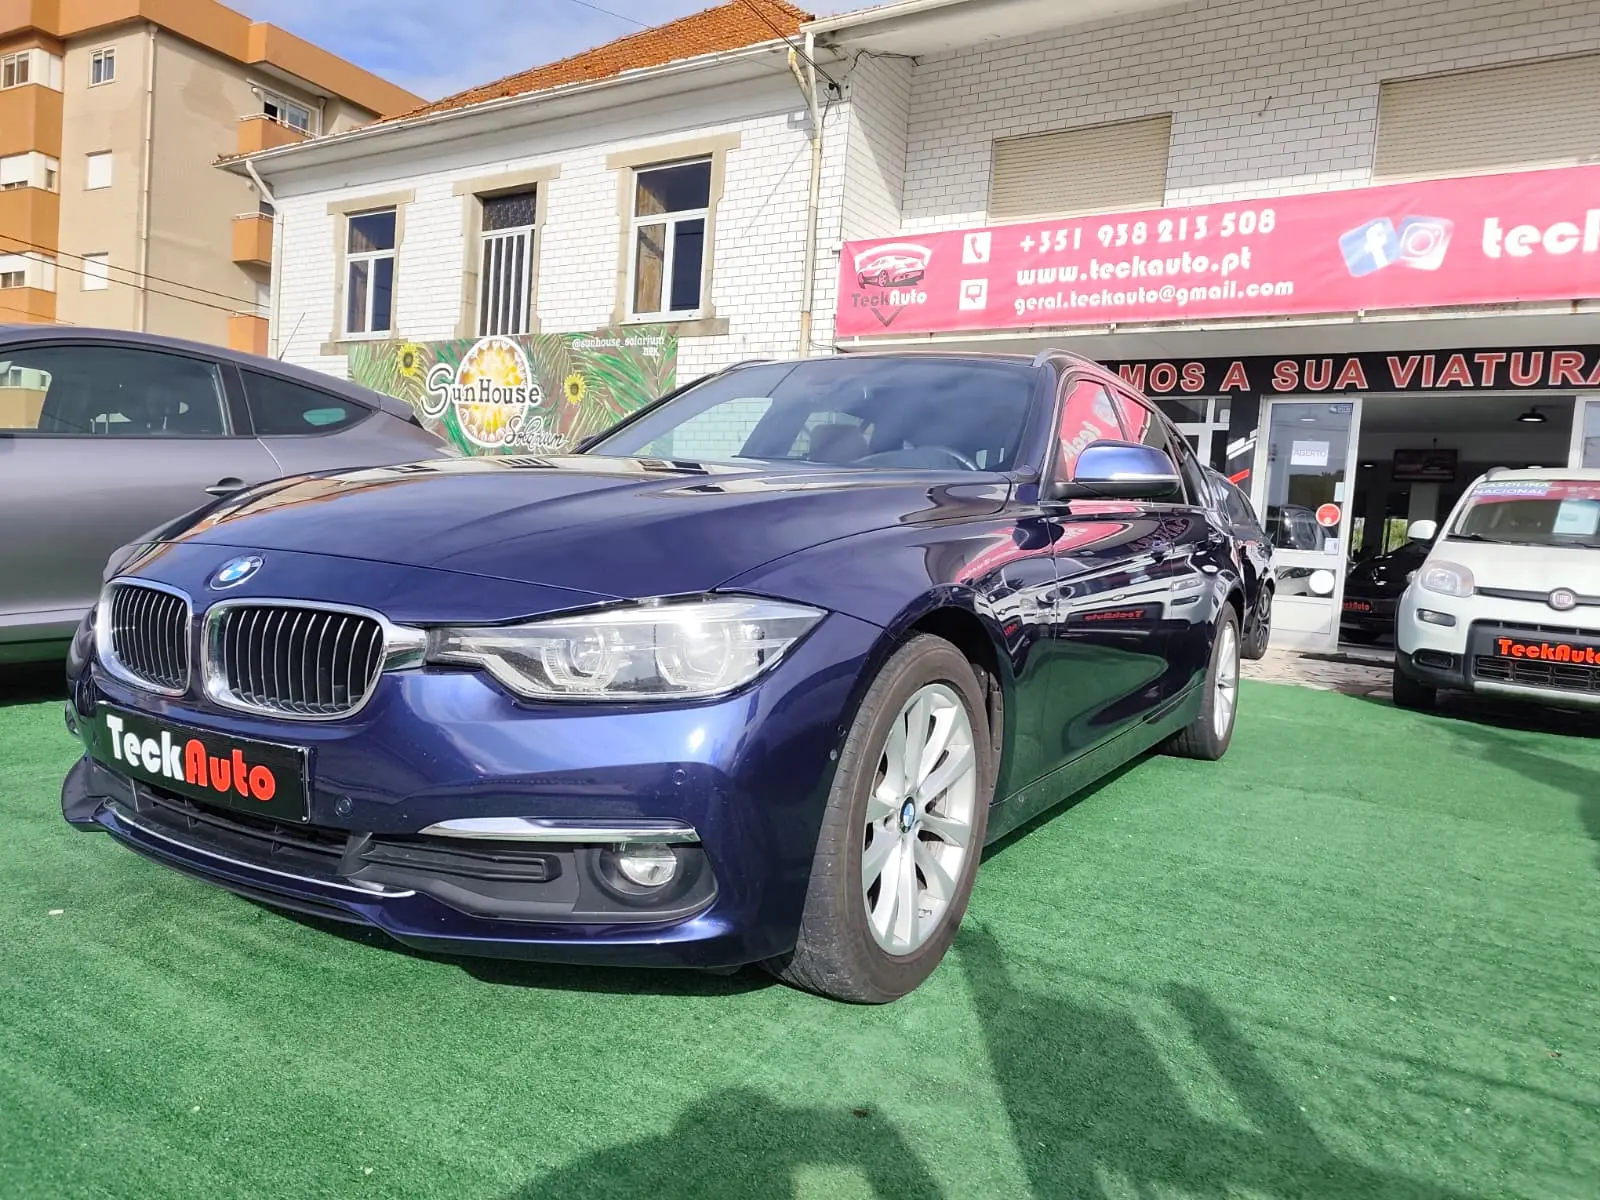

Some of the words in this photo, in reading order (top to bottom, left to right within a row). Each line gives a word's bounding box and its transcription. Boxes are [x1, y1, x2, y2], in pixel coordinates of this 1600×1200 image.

[1019, 227, 1082, 254] +351
[1097, 221, 1147, 248] 938
[1157, 215, 1208, 243] 213
[1219, 208, 1277, 238] 508
[1016, 246, 1252, 286] www.teckauto.pt
[851, 288, 928, 308] TeckAuto
[1013, 280, 1294, 315] geral.teckauto@gmail.com
[1219, 361, 1251, 392] A
[1271, 357, 1369, 392] SUA
[106, 714, 276, 801] TeckAuto
